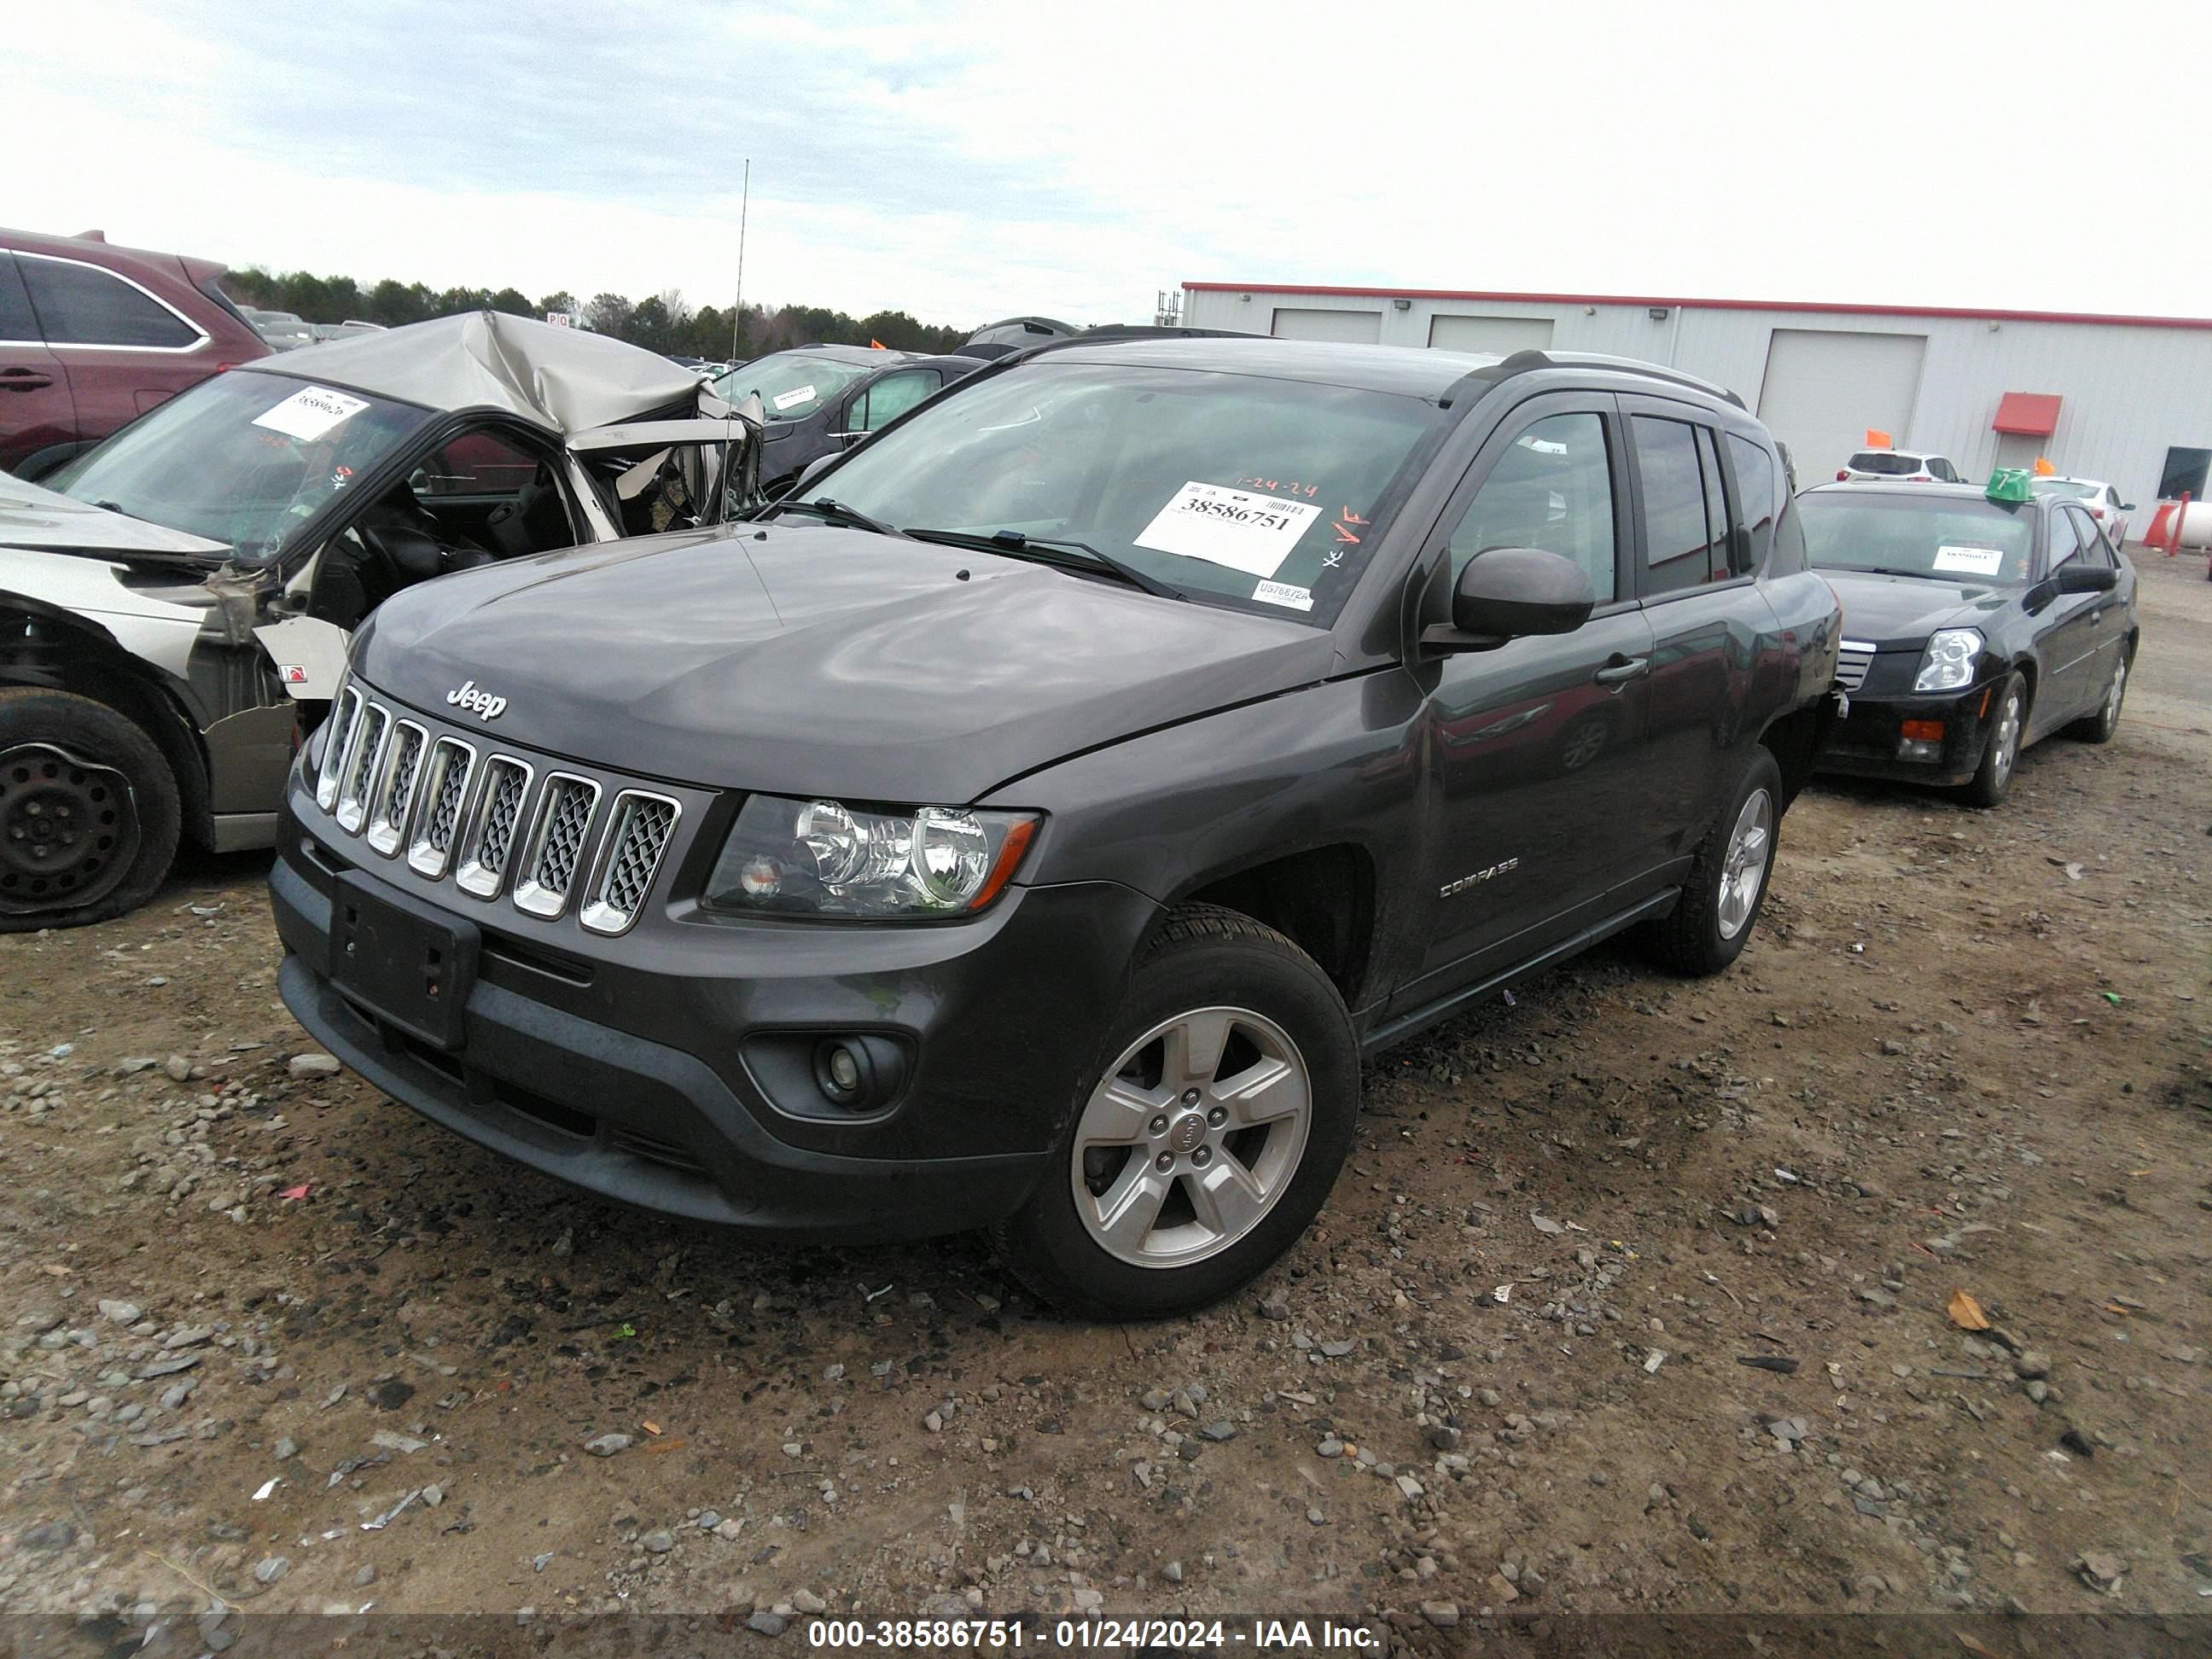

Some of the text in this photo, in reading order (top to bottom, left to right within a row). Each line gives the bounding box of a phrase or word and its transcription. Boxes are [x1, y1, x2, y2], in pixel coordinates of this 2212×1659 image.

[550, 314, 567, 325] P Q
[1237, 477, 1318, 498] 1-24-24
[1181, 498, 1290, 531] 38586751
[446, 680, 508, 722] Jeep
[1440, 858, 1518, 899] COMPASS
